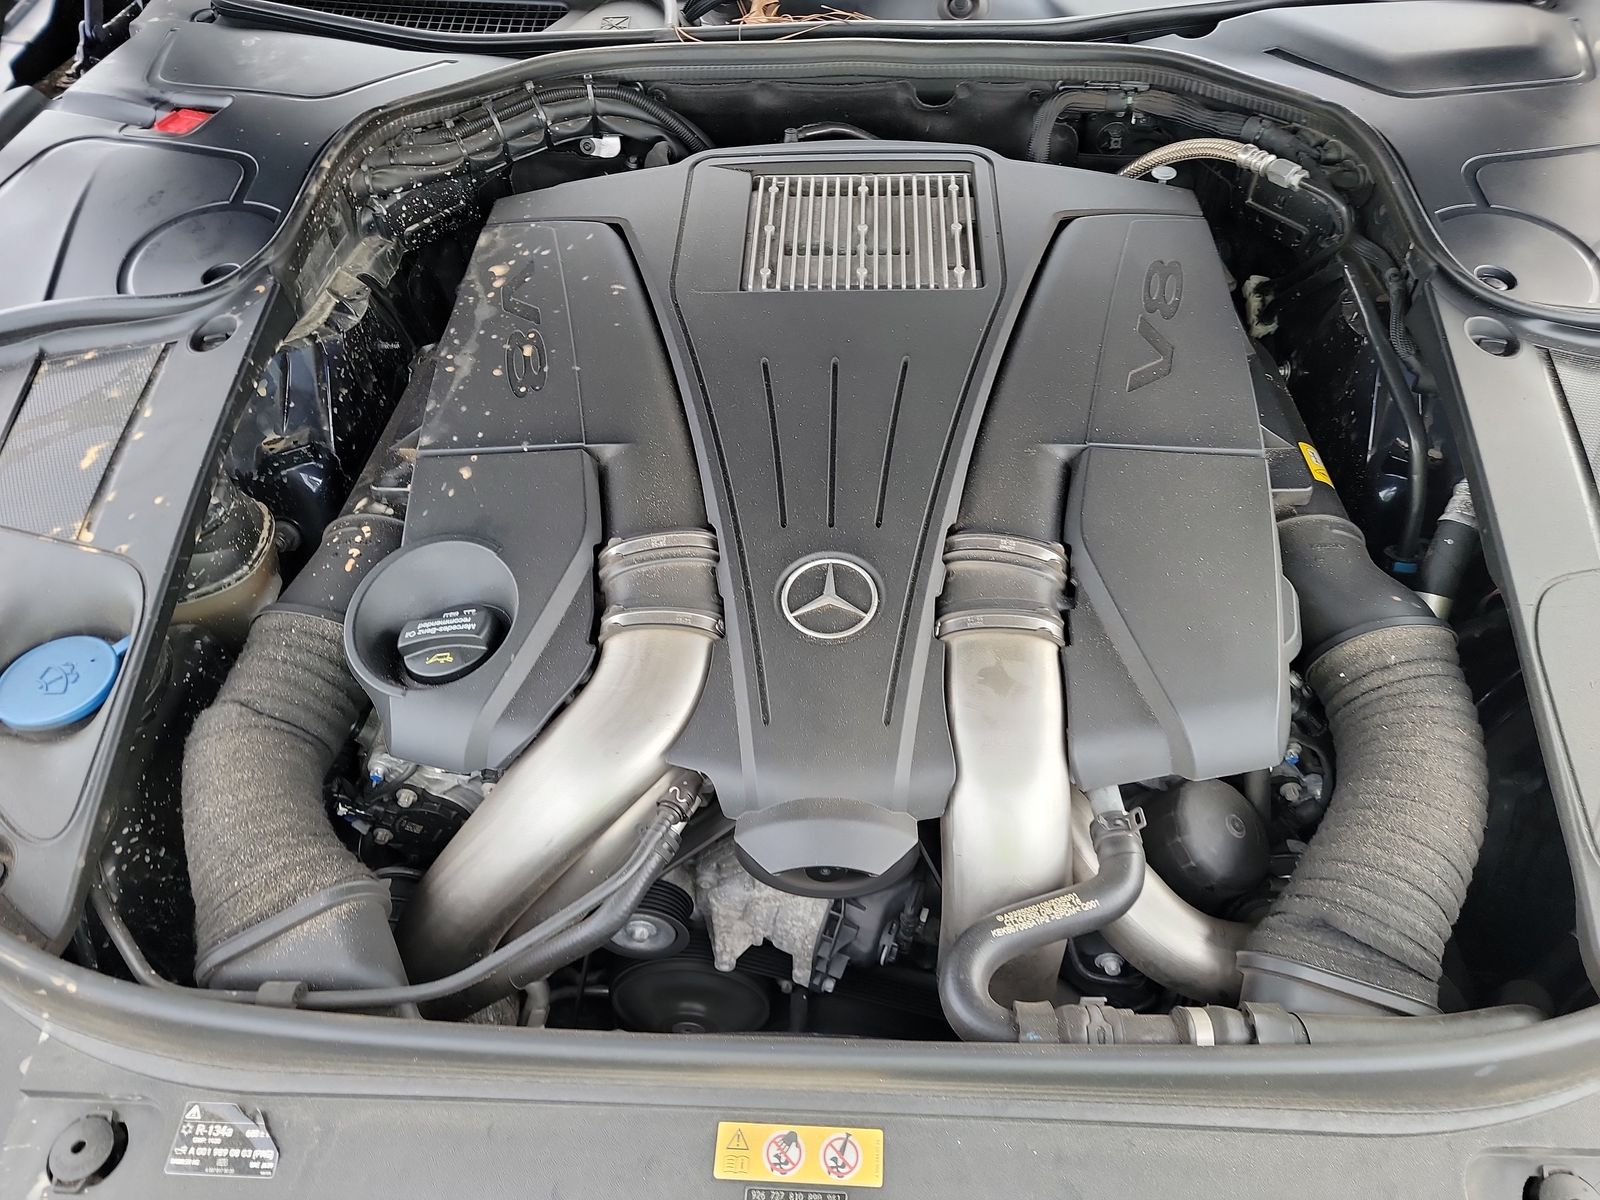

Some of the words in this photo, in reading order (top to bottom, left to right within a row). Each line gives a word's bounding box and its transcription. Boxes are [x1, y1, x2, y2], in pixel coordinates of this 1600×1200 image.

[500, 259, 548, 399] V8
[1126, 259, 1184, 393] V8
[417, 616, 472, 630] recommended
[417, 623, 477, 636] Mercedes-Benz
[195, 1124, 234, 1138] R-134a
